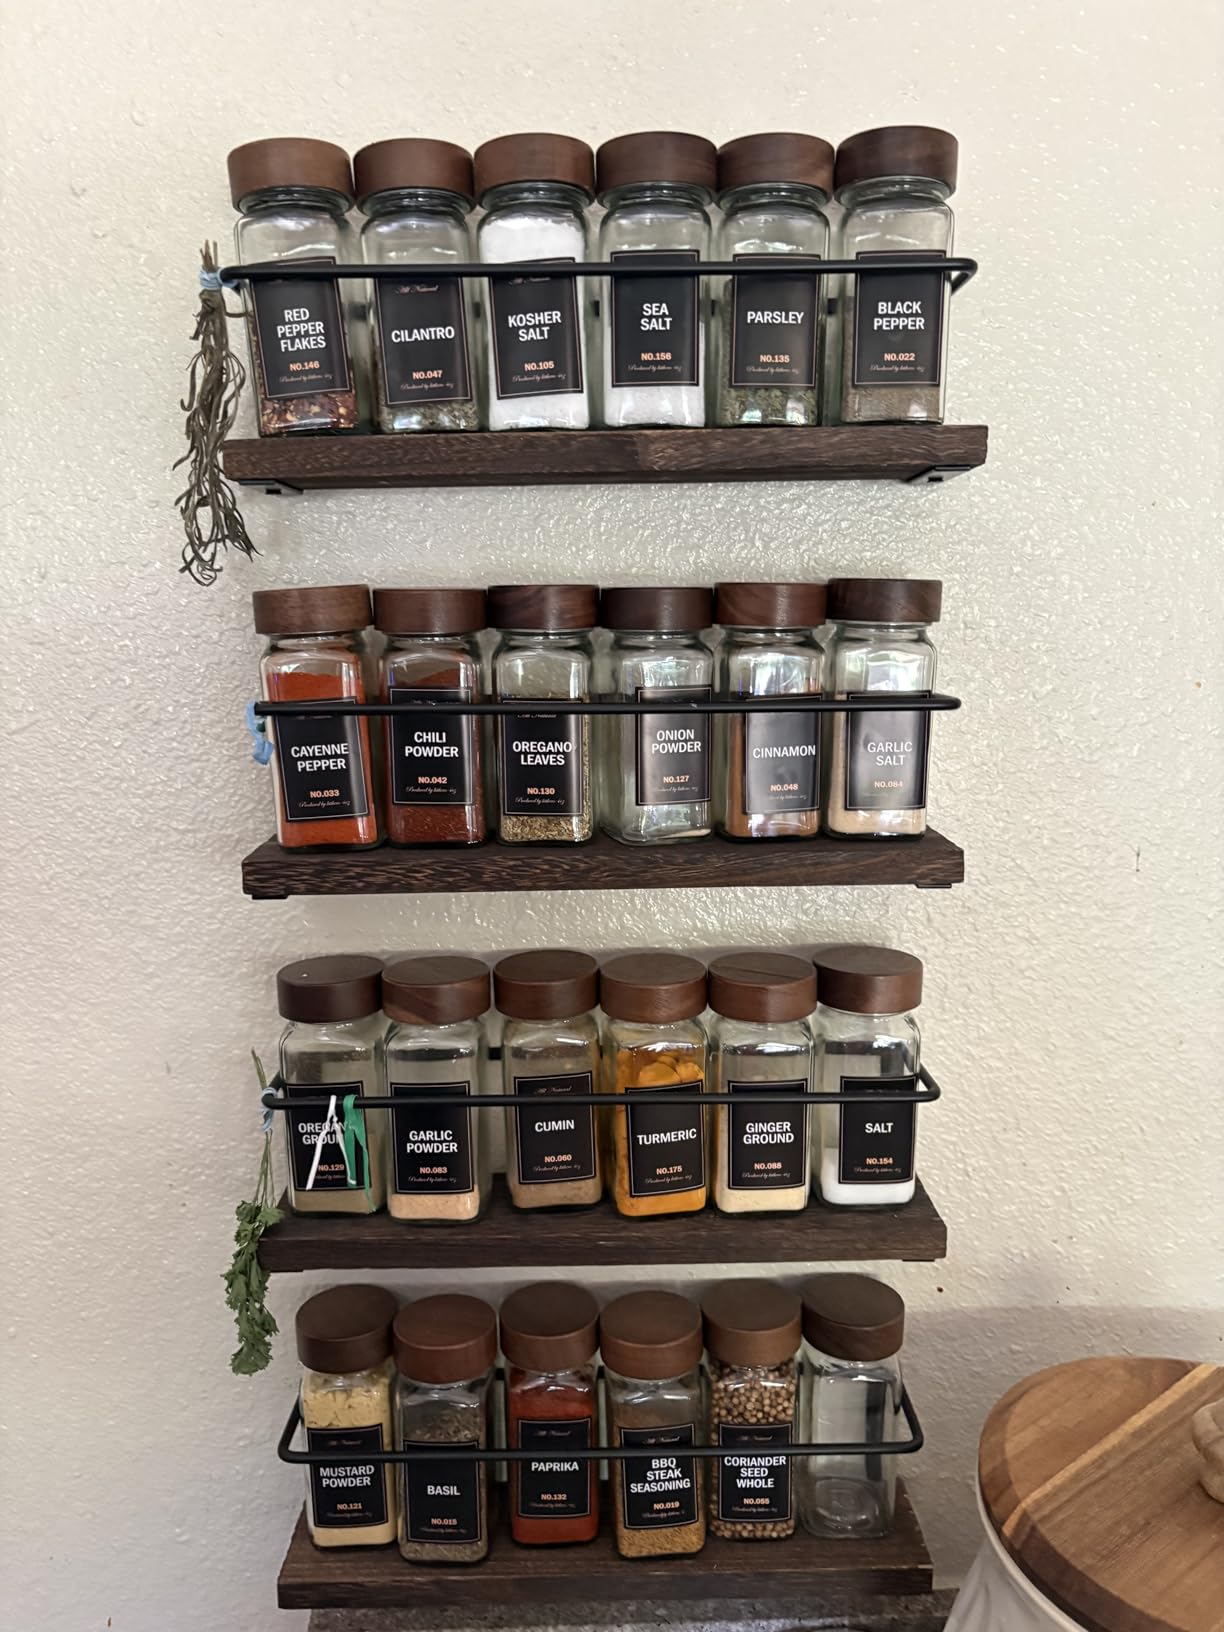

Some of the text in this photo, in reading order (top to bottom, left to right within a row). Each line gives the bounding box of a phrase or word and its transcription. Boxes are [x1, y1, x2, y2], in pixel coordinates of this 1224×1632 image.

[642, 303, 669, 316] SEA
[877, 301, 922, 315] BLACK
[284, 308, 310, 323] RED
[508, 310, 562, 328] KOSHER
[747, 311, 804, 325] PARSLEY
[276, 322, 324, 338] PEPPER
[640, 317, 673, 331] SALT
[873, 317, 925, 331] PEPPER
[391, 326, 455, 343] CILANTRO
[518, 327, 550, 342] SALT
[280, 336, 326, 353] FLAKES
[640, 352, 672, 361] NO.156
[759, 355, 790, 364] NO.135
[883, 353, 916, 362] NO.022
[289, 360, 320, 372] NO.146
[524, 361, 555, 372] NO.105
[412, 370, 443, 381] NO.047
[414, 731, 447, 743] CHILI
[656, 729, 695, 741] ONION
[290, 742, 349, 758] CAYENNE
[404, 745, 459, 758] POWDER
[512, 741, 572, 753] OREGANO
[651, 741, 702, 754] POWDER
[753, 745, 816, 759] CINNAMON
[867, 741, 913, 753] GARLIC
[297, 758, 346, 772] PEPPER
[520, 754, 565, 765] LEAVES
[876, 754, 906, 766] SALT
[418, 776, 448, 784] NO.042
[663, 775, 690, 783] NO.127
[527, 787, 555, 795] NO.130
[770, 783, 799, 792] NO.048
[309, 789, 340, 799] NO.033
[298, 1121, 350, 1133] OREGAN
[534, 1119, 575, 1132] CUMIN
[745, 1122, 791, 1133] GINGER
[865, 1122, 894, 1133] SALT
[302, 1133, 345, 1146] GROU
[409, 1130, 453, 1141] GARLIC
[637, 1128, 697, 1145] TURMERIC
[743, 1132, 794, 1144] GROUND
[406, 1141, 458, 1154] POWDER
[544, 1154, 572, 1163] NO.060
[866, 1157, 893, 1165] NO.154
[419, 1166, 448, 1174] NO.083
[656, 1166, 683, 1175] NO.175
[531, 1461, 579, 1472] PAPRIKA
[651, 1457, 676, 1469] BBQ
[724, 1455, 787, 1466] CORIANDER
[319, 1465, 375, 1477] MUSTARD
[646, 1469, 682, 1481] STEAK
[740, 1467, 768, 1478] SEED
[322, 1476, 371, 1488] POWDER
[630, 1478, 691, 1493] SEASONING
[736, 1478, 775, 1489] WHOLE
[427, 1485, 461, 1496] BASIL
[337, 1502, 362, 1511] NO.121
[653, 1501, 680, 1510] NO.019
